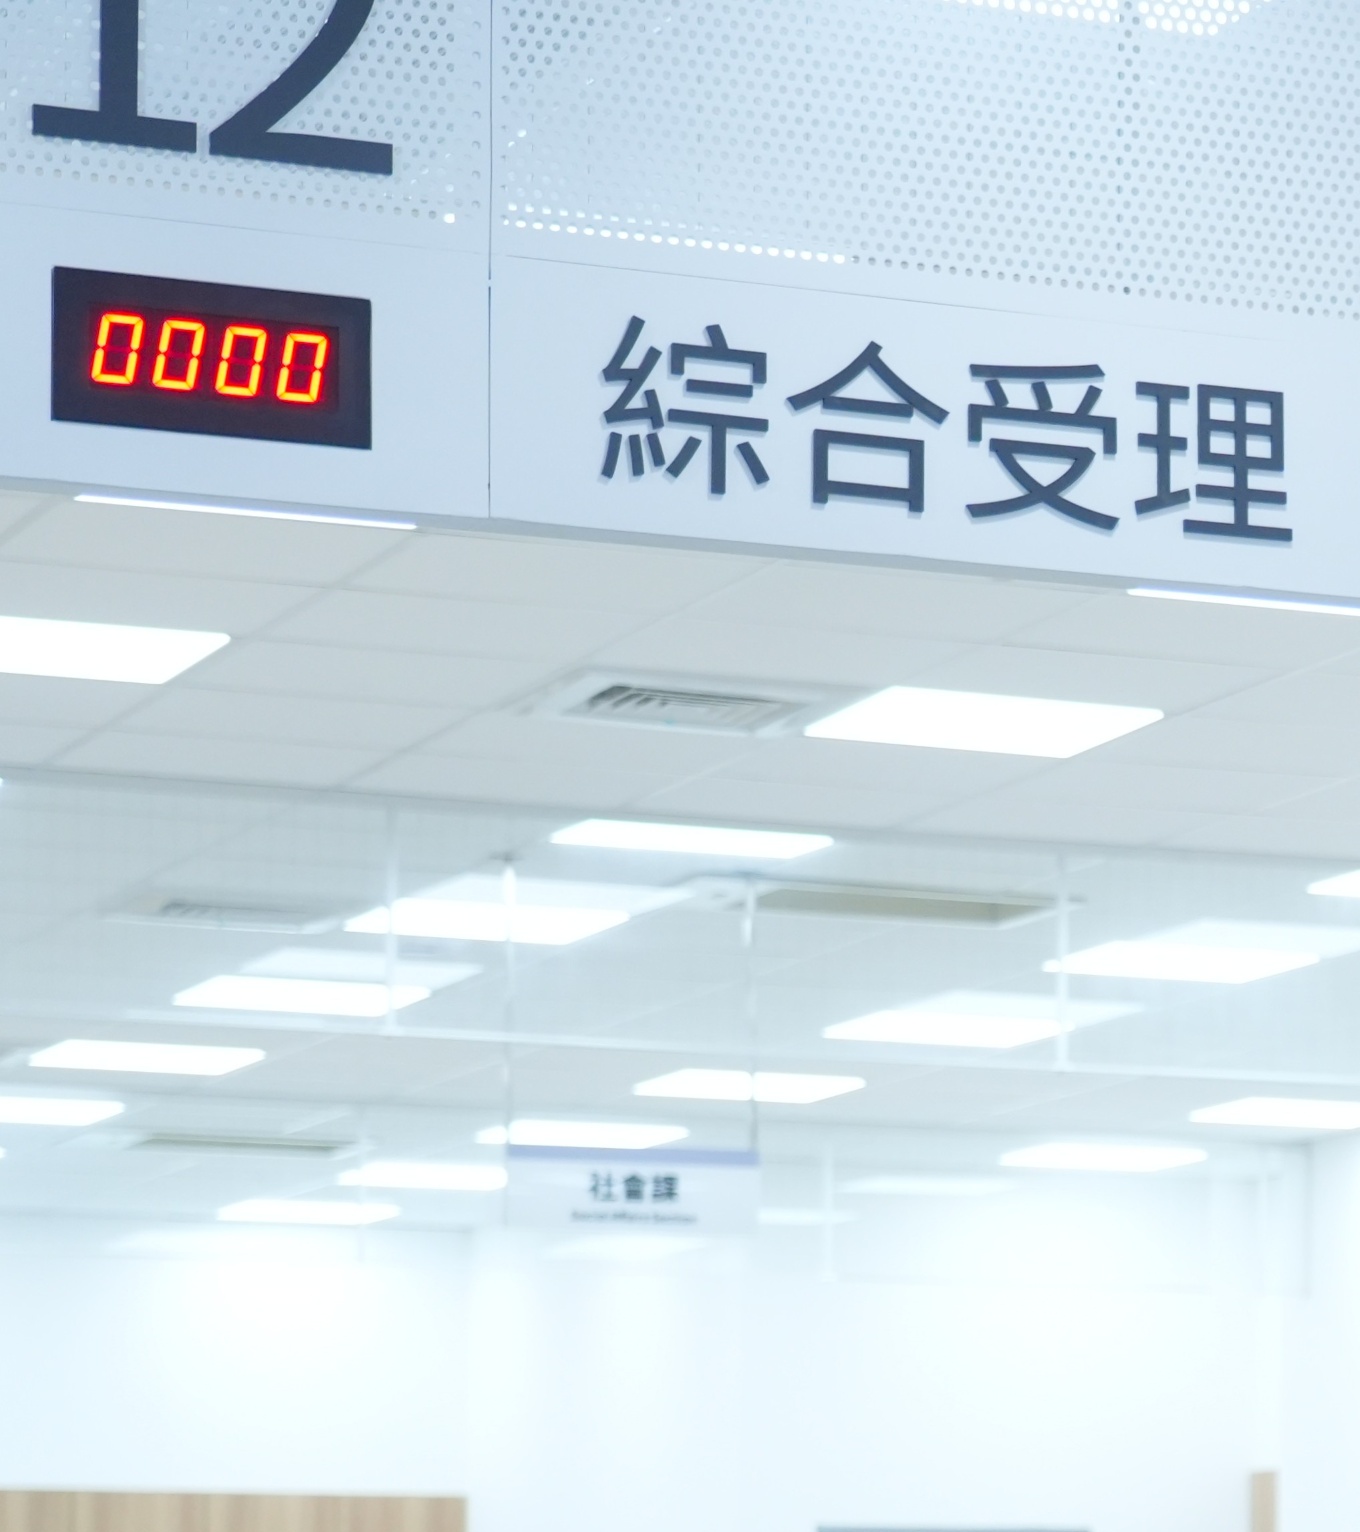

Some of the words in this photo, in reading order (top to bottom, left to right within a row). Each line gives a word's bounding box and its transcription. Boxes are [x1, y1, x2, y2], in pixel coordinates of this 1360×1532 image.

[91, 311, 330, 405] 0000
[600, 315, 1293, 543] 綜合受理
[589, 1171, 679, 1202] 社會課
